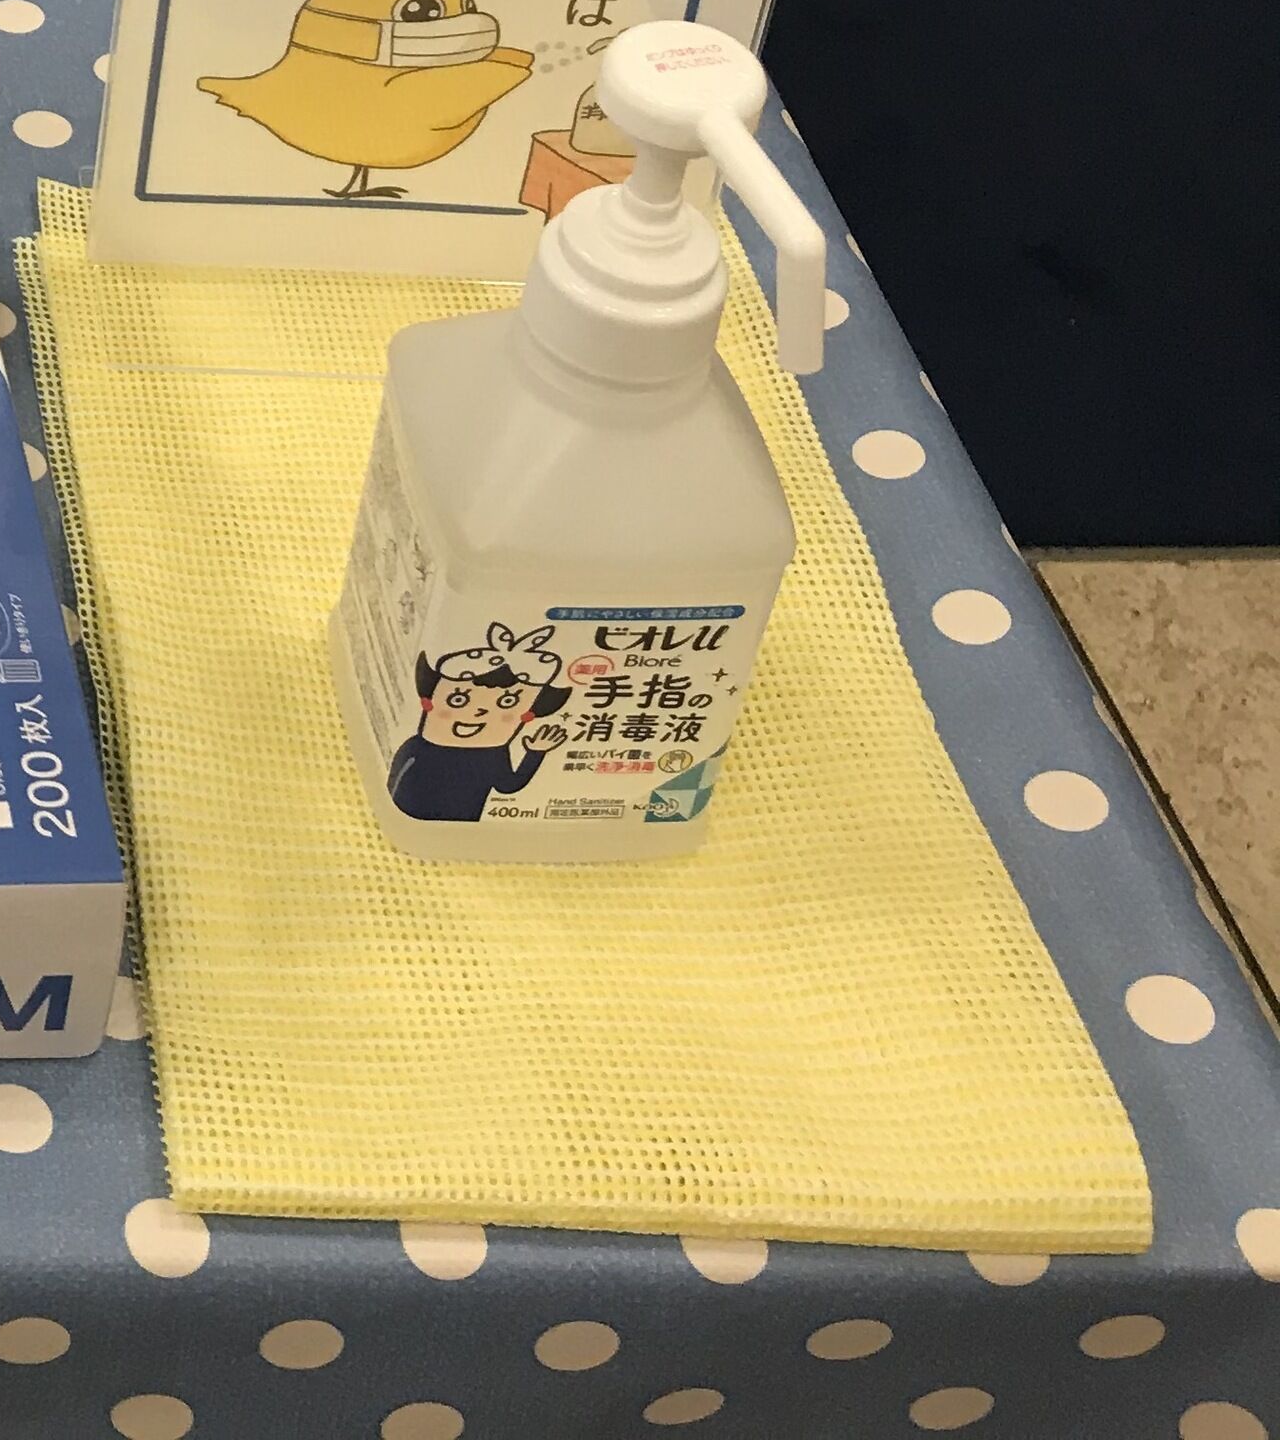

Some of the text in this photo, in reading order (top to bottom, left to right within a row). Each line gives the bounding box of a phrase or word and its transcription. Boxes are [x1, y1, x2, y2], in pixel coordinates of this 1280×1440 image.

[583, 673, 714, 710] 手指の
[570, 713, 708, 744] 消毒液
